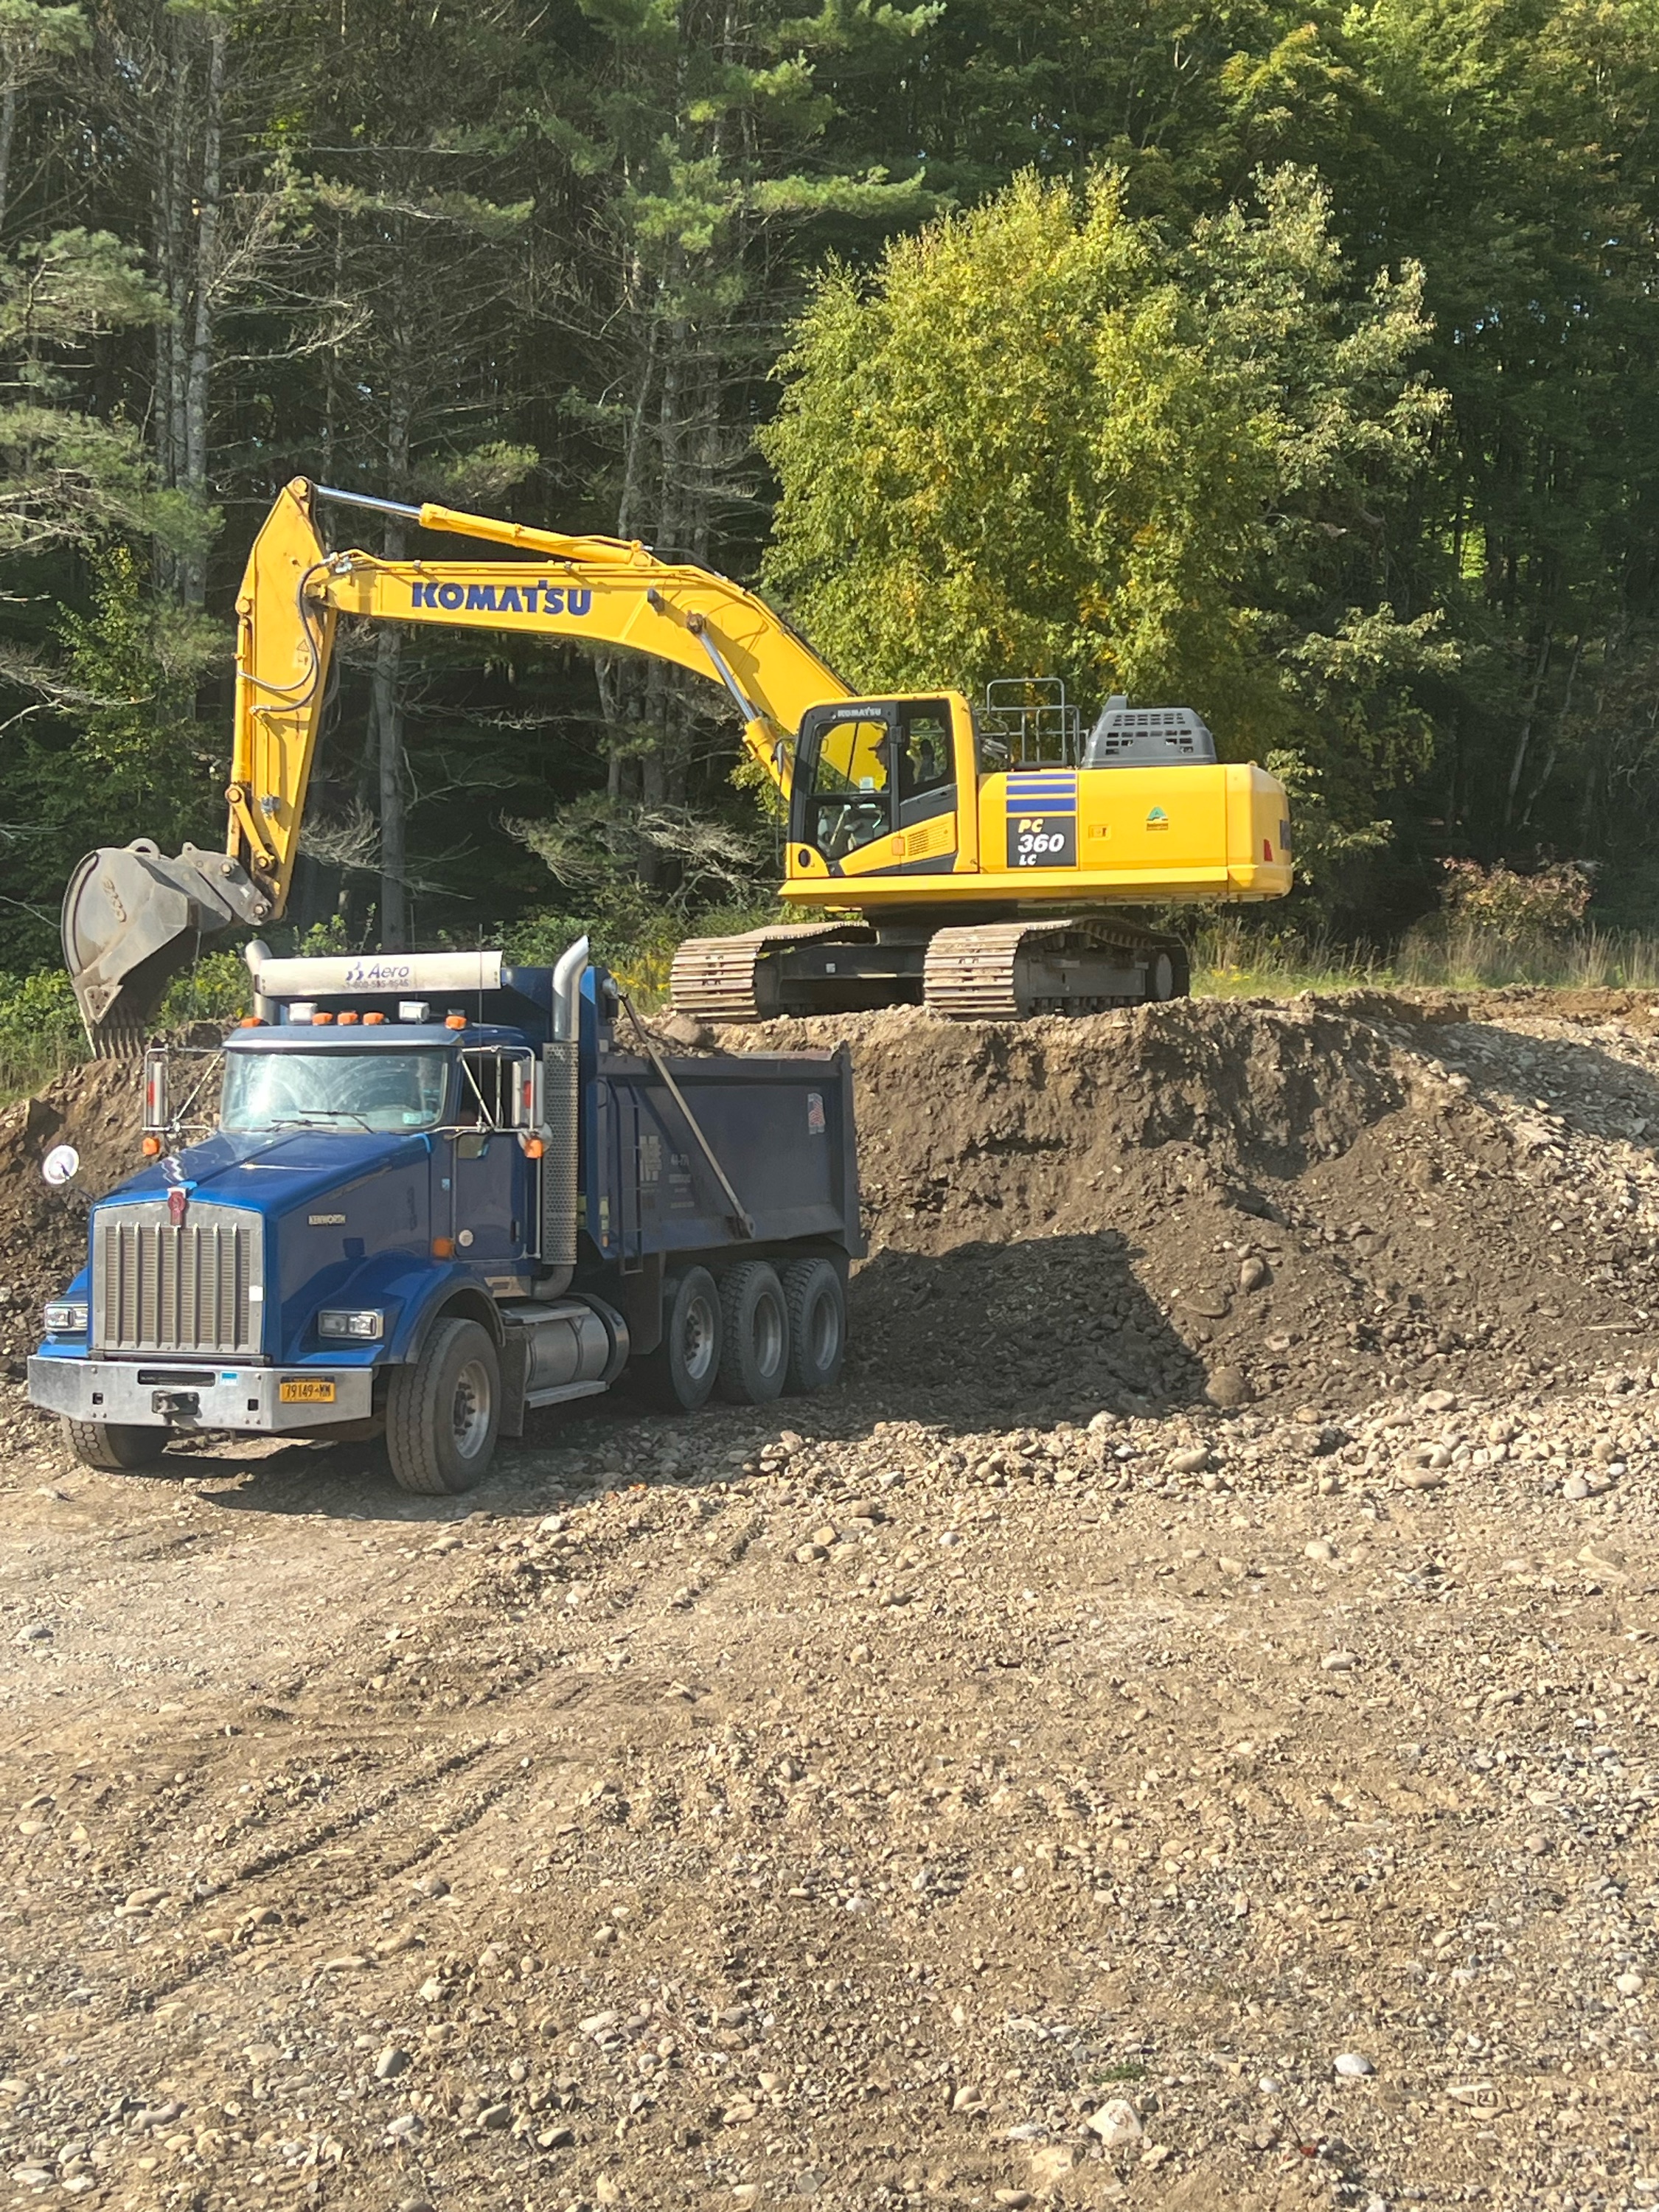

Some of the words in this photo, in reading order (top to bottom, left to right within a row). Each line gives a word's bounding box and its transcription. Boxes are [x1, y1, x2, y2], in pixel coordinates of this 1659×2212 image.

[411, 580, 591, 616] KOMATSU
[838, 706, 881, 717] KOMATSU
[1018, 818, 1043, 833] PC
[1018, 833, 1065, 853] 360
[1019, 854, 1037, 866] LC
[368, 963, 409, 978] Aero
